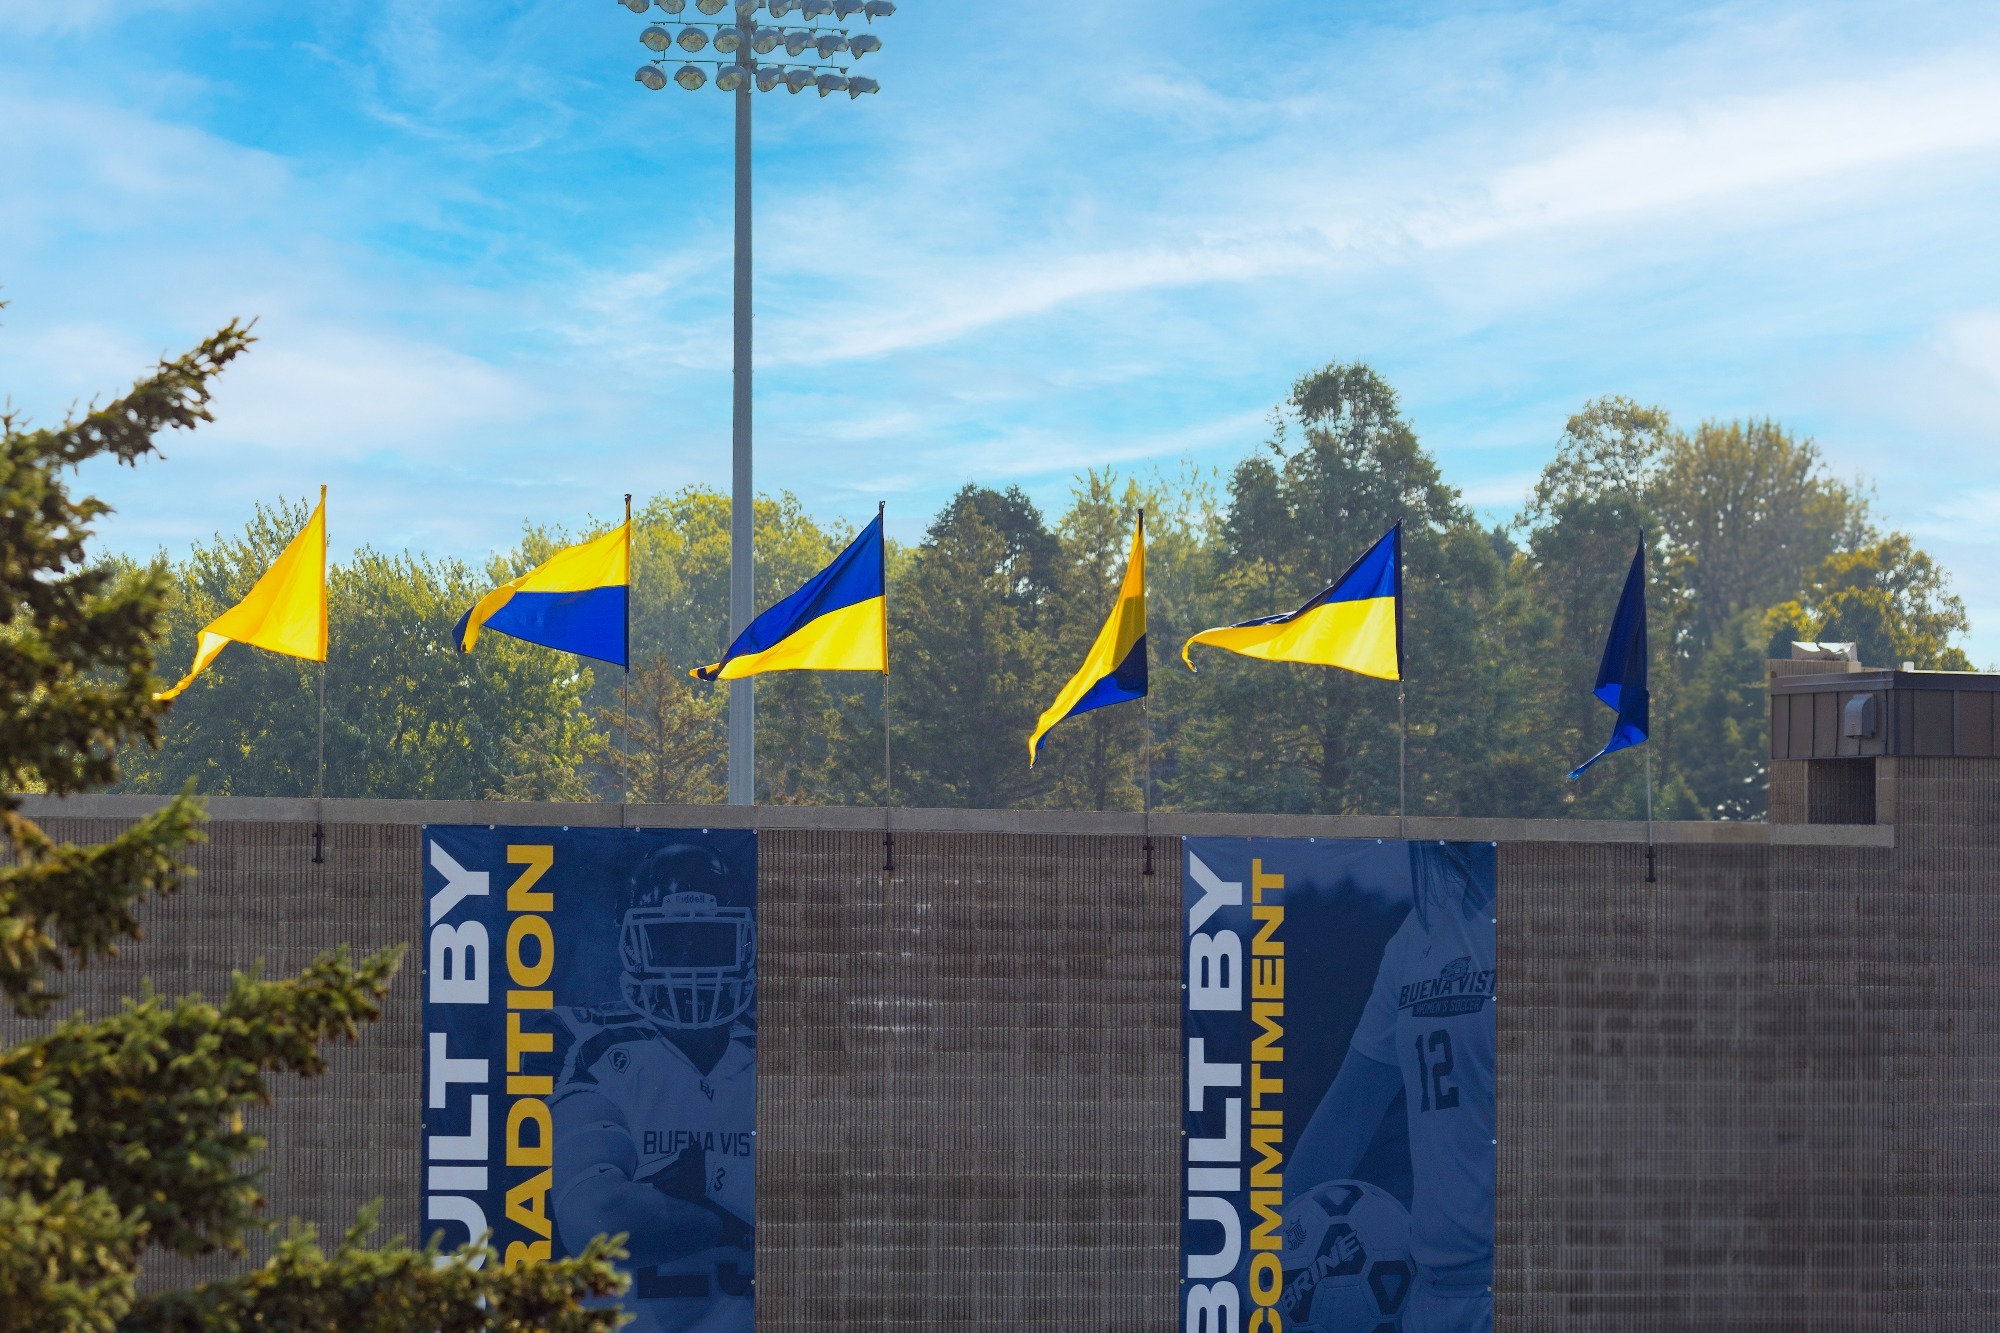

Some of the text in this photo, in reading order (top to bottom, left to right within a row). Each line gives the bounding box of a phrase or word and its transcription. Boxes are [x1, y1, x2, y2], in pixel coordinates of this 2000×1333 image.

[1398, 977, 1453, 1007] BUENA
[1415, 997, 1481, 1015] WOMEN'S SOCCER
[428, 839, 490, 1273] UILT BY
[504, 844, 554, 1276] RADITION
[1186, 850, 1243, 1333] BUILT BY
[1414, 1028, 1460, 1112] 12
[1280, 1229, 1361, 1317] BRINE
